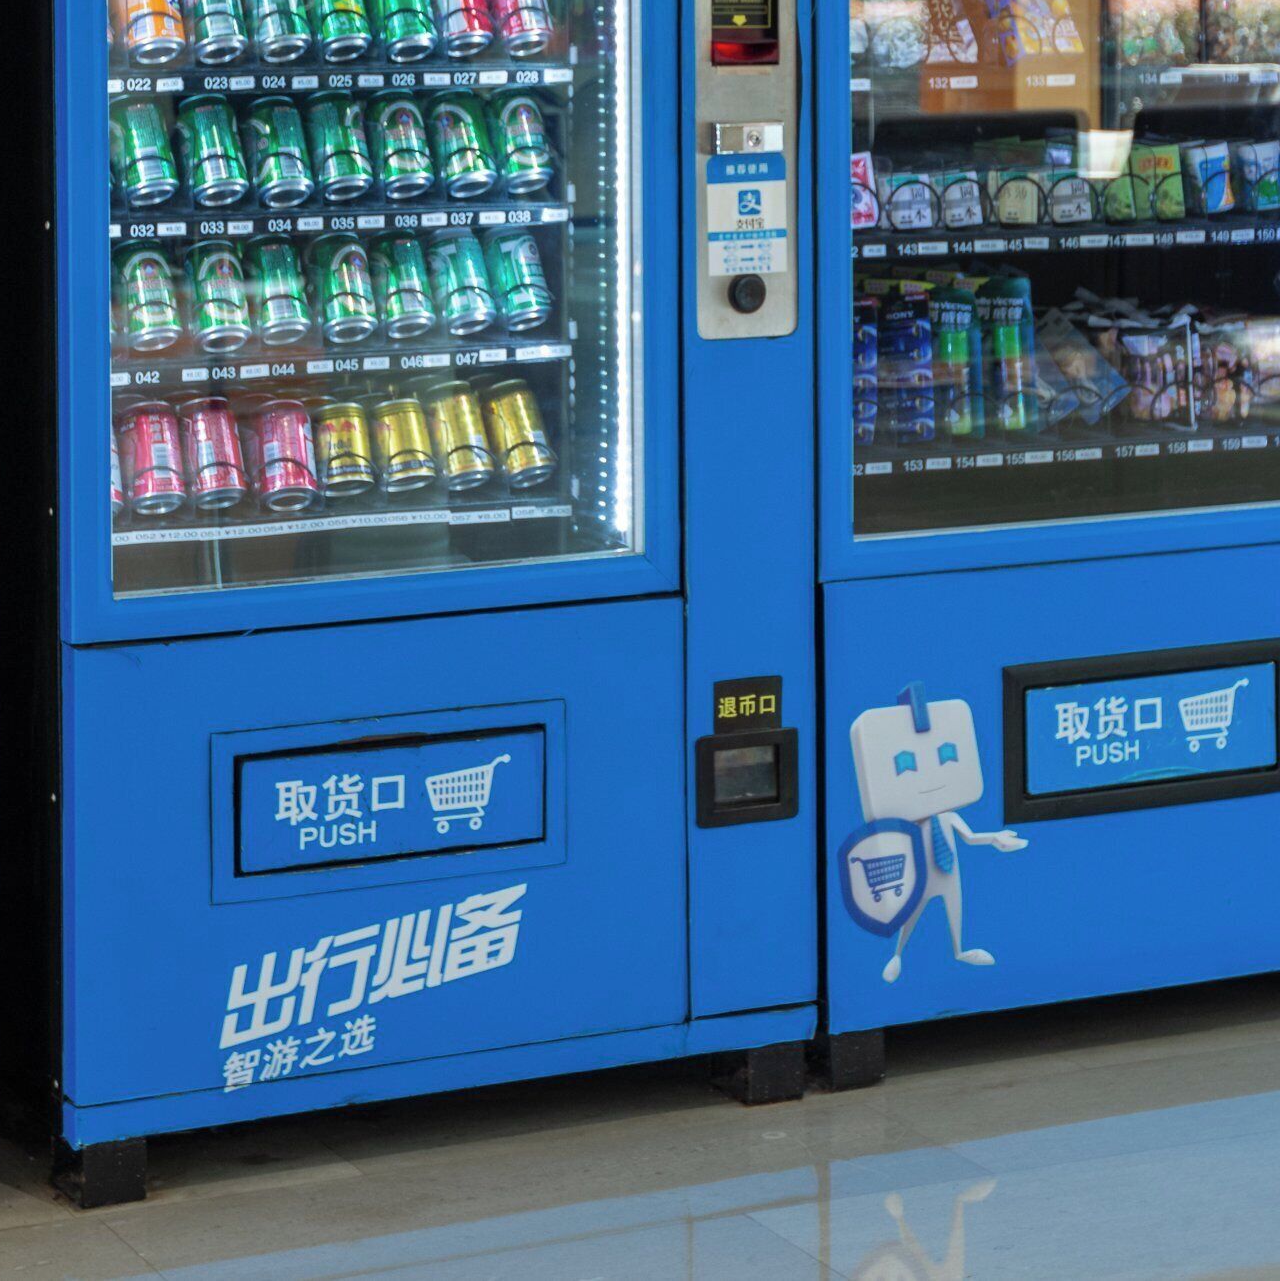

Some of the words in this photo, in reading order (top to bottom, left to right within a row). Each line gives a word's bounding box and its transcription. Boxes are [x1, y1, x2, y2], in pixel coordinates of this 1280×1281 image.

[127, 78, 151, 91] 022
[205, 77, 228, 90] 023
[262, 76, 285, 88] 024
[329, 75, 352, 87] 025
[392, 74, 416, 86] 026
[454, 72, 477, 85] 027
[516, 71, 539, 83] 028
[130, 224, 154, 237] 032
[200, 222, 224, 234] 033
[268, 219, 291, 232] 034
[331, 217, 354, 230] 035
[395, 215, 418, 227] 036
[450, 213, 474, 225] 037
[508, 210, 531, 223] 038
[736, 218, 764, 229] 支付宝
[897, 243, 918, 255] 143
[953, 242, 973, 253] 144
[1060, 237, 1079, 249] 146
[1108, 236, 1127, 247] 147
[135, 371, 160, 384] 042
[212, 367, 236, 379] 043
[272, 364, 295, 376] 044
[336, 359, 359, 372] 045
[401, 356, 423, 369] 046
[456, 353, 478, 365] 047
[904, 460, 923, 472] 153
[956, 457, 974, 468] 154
[1006, 454, 1025, 465] 155
[718, 694, 776, 718] 退币口
[1055, 696, 1163, 744] 取货口
[1076, 740, 1140, 767] PUSH
[275, 774, 406, 826] 取货口
[299, 820, 378, 851] PUSH
[219, 883, 528, 1050] 出行必备
[222, 1014, 377, 1093] 智游之选
